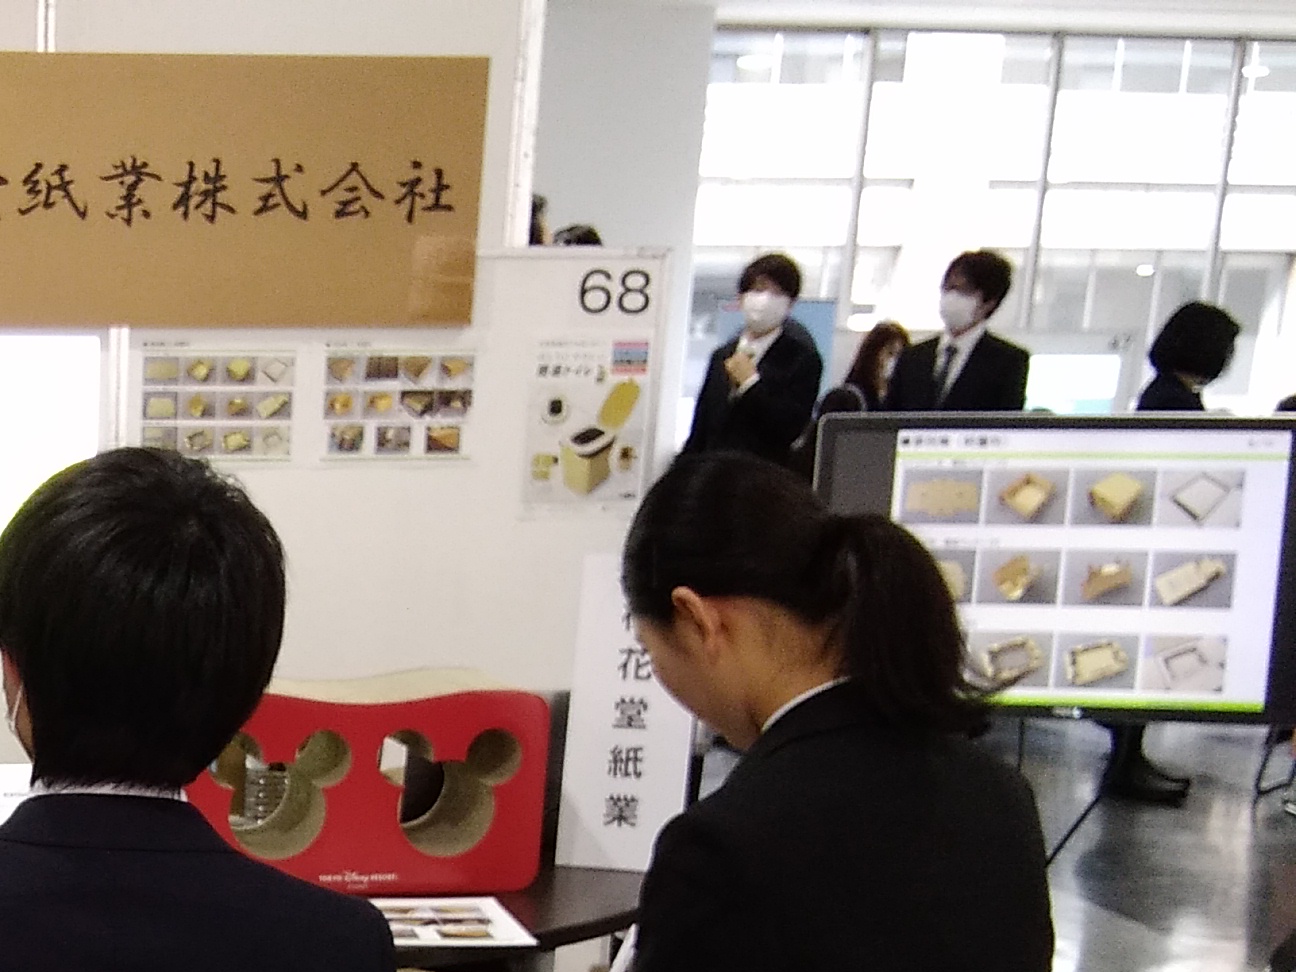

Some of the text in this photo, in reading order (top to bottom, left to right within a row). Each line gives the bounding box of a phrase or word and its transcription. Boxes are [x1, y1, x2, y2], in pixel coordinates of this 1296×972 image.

[579, 268, 651, 314] 68
[603, 605, 653, 827] 花堂紙業
